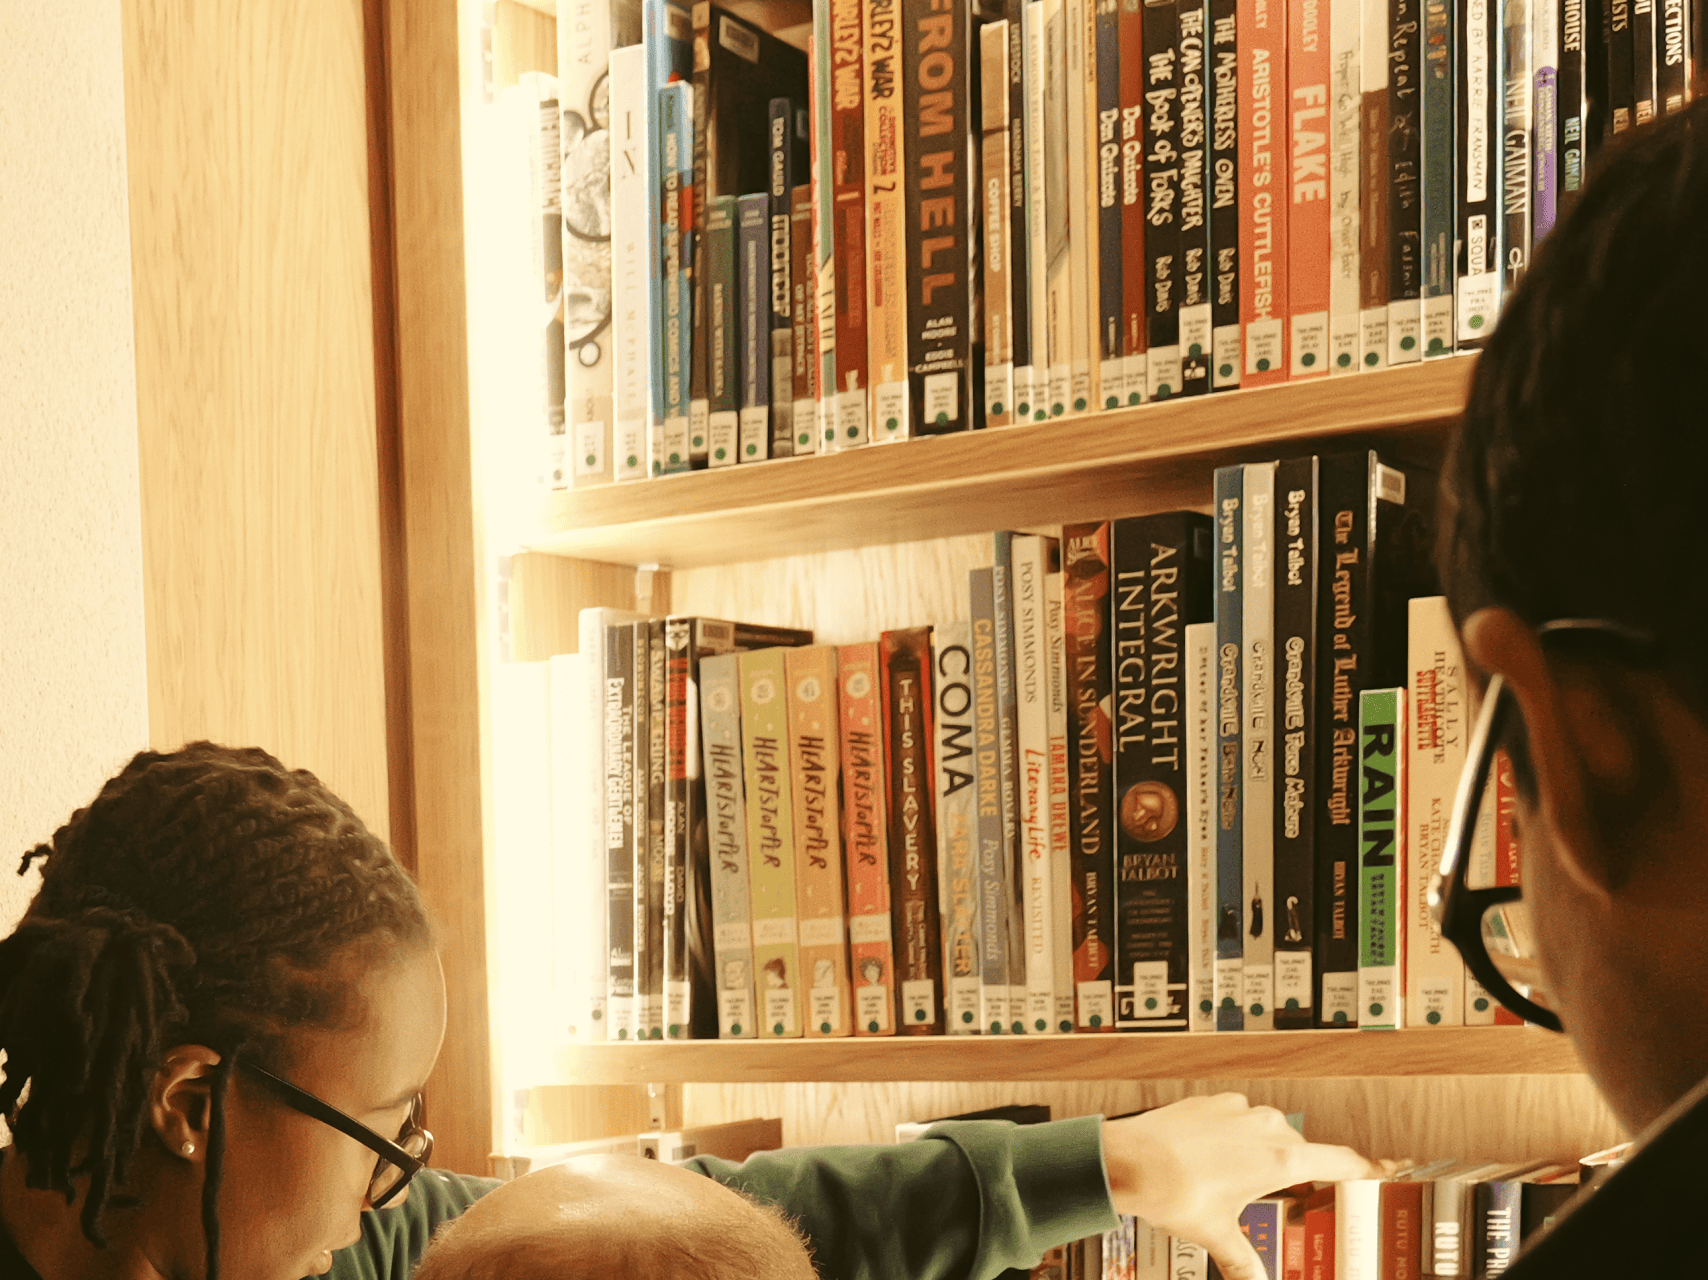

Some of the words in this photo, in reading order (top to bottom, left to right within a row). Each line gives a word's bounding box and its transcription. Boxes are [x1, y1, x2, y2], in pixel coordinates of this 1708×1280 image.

[1181, 9, 1203, 38] THE
[1213, 14, 1235, 46] THE
[1471, 28, 1485, 47] BY
[1564, 0, 1580, 52] HOUSE
[1665, 0, 1682, 66] ECTIONS
[871, 55, 895, 101] WAR
[1011, 22, 1022, 85] LIVESTOCK
[1149, 48, 1174, 84] THE
[1389, 21, 1418, 101] Repeat
[1471, 54, 1485, 110] KARRIE
[835, 63, 861, 110] WAR
[1505, 78, 1527, 124] NEIL
[773, 117, 784, 147] TOM
[1100, 107, 1118, 141] Don
[1124, 105, 1141, 139] Don
[1252, 48, 1271, 187] ARISTOTLE'S
[1293, 84, 1327, 204] FLAKE
[1565, 117, 1580, 144] NEIL
[1101, 142, 1120, 208] Quixote
[1124, 139, 1142, 205] Quixote
[1213, 159, 1235, 209] OVEN
[1471, 119, 1485, 191] FRANSMAN
[1504, 130, 1528, 215] GAIMAN
[922, 151, 955, 305] HELL
[988, 178, 1001, 233] COFFEE
[989, 235, 1001, 272] SHOP
[1253, 192, 1273, 322] CUTTLEFISH
[1219, 497, 1240, 544] Bryan
[1284, 489, 1306, 538] Bryan
[1333, 510, 1353, 544] The
[1020, 561, 1034, 603] POSY
[1221, 544, 1239, 593] Talbot
[1287, 538, 1305, 586] Talbot
[1328, 547, 1359, 629] Legend
[1048, 599, 1063, 633] Posy
[1074, 578, 1097, 651] ALICE
[1333, 633, 1352, 650] of
[975, 619, 998, 746] CASSANDRA
[1022, 607, 1037, 704] SIMMONDS
[1050, 635, 1065, 714] Simmonds
[1077, 655, 1098, 684] IN
[1117, 569, 1147, 754] INTEGRAL
[1150, 542, 1180, 771] ARKWRIGHT
[900, 679, 916, 748] THIS
[1332, 653, 1357, 721] Luther
[1432, 650, 1446, 764] HEATHCOTE
[1445, 665, 1459, 749] SALLY
[622, 705, 633, 736] THE
[939, 644, 975, 798] COMA
[622, 742, 633, 803] LEAGUE
[979, 751, 999, 818] DARKE
[1049, 734, 1067, 796] TAMARA
[1078, 688, 1101, 856] SUNDERLAND
[1327, 727, 1356, 825] Arkwright
[709, 743, 739, 874] HEARTSTOPPER
[752, 736, 782, 868] HEARTSTOPPER
[797, 735, 828, 869] HEARTSTOPPER
[848, 731, 878, 867] HEARTSTOPPER
[902, 757, 921, 891] SLAVERY
[1362, 722, 1394, 869] RAIN
[1430, 797, 1441, 837] KATE
[980, 839, 1000, 876] Posy
[1121, 866, 1177, 882] TALBOT
[1122, 853, 1176, 869] BRYAN
[1418, 823, 1429, 869] BRYAN
[984, 879, 1003, 960] Simmonds
[1031, 876, 1044, 955] REVISITED
[1418, 876, 1429, 931] TALBOT
[1347, 1213, 1363, 1252] rutu
[1394, 1209, 1409, 1250] RUTU
[1435, 1221, 1460, 1276] RUTU
[1486, 1207, 1512, 1241] THE
